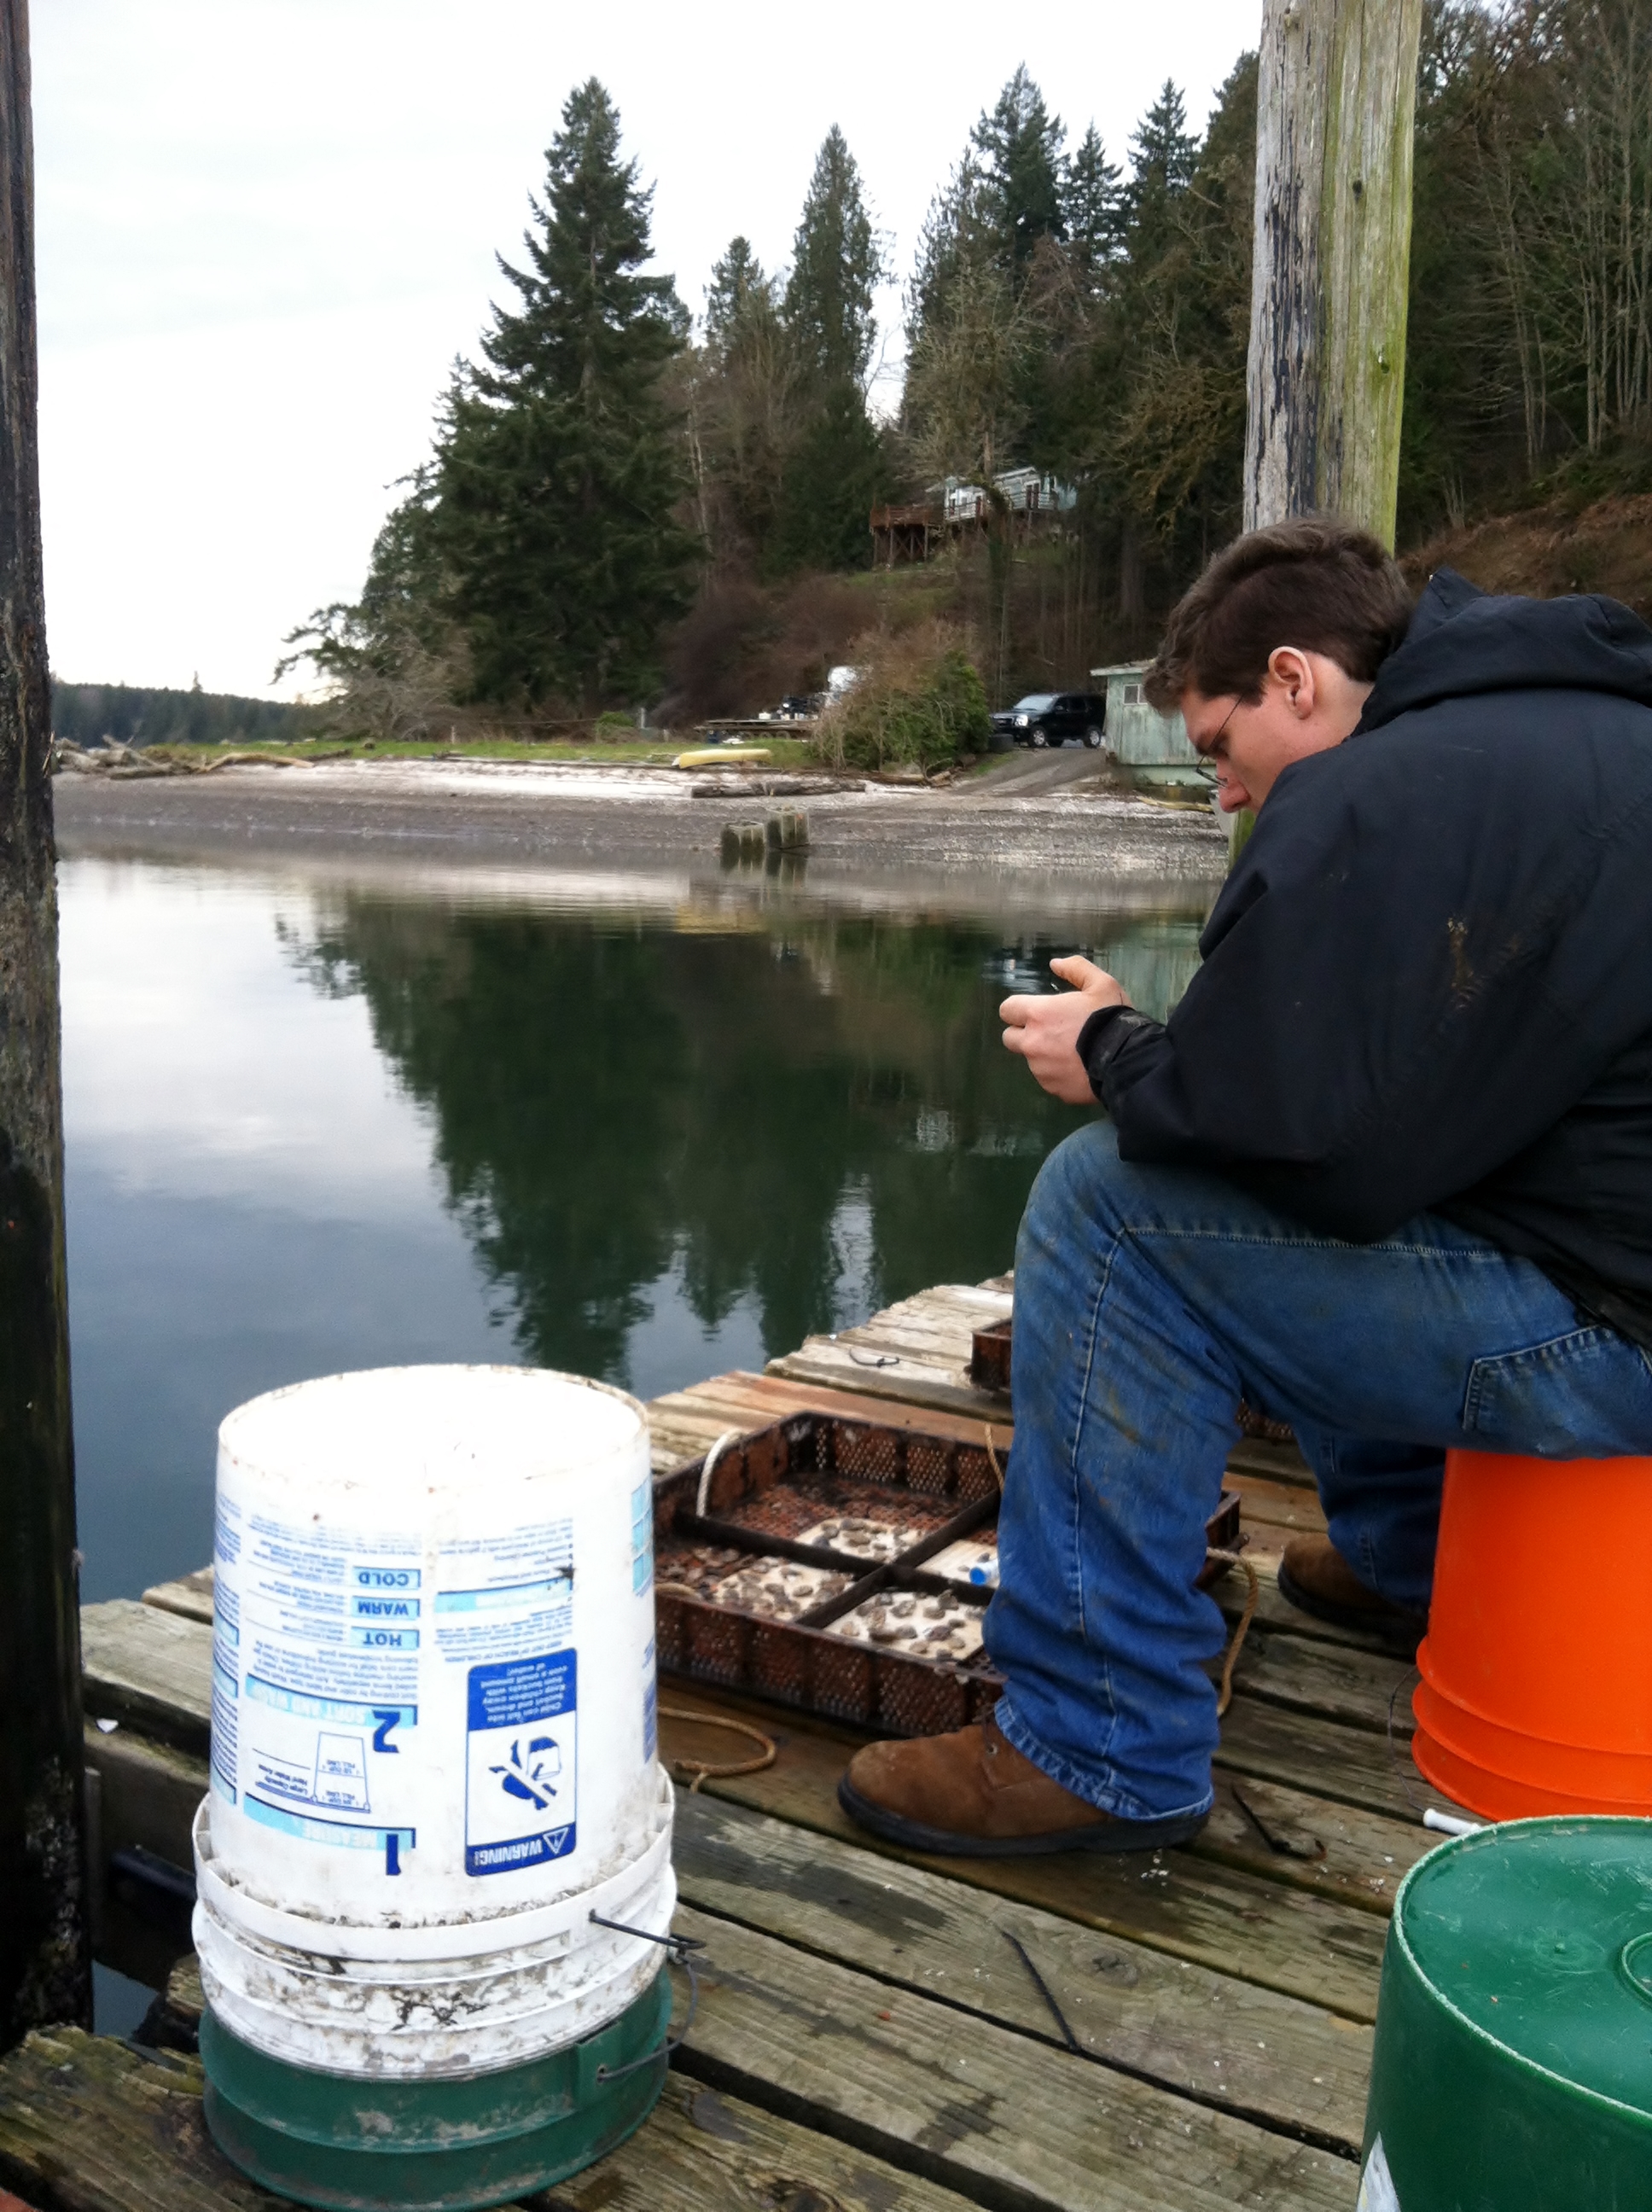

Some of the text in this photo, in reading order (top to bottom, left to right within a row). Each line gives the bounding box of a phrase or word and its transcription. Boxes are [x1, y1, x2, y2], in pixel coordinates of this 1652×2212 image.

[358, 1573, 409, 1586] COLD
[358, 1602, 409, 1615] WARM
[364, 1633, 401, 1646] HOT
[372, 1711, 399, 1753] 2
[386, 1834, 401, 1876] 1
[474, 1839, 543, 1866] WARNING!
